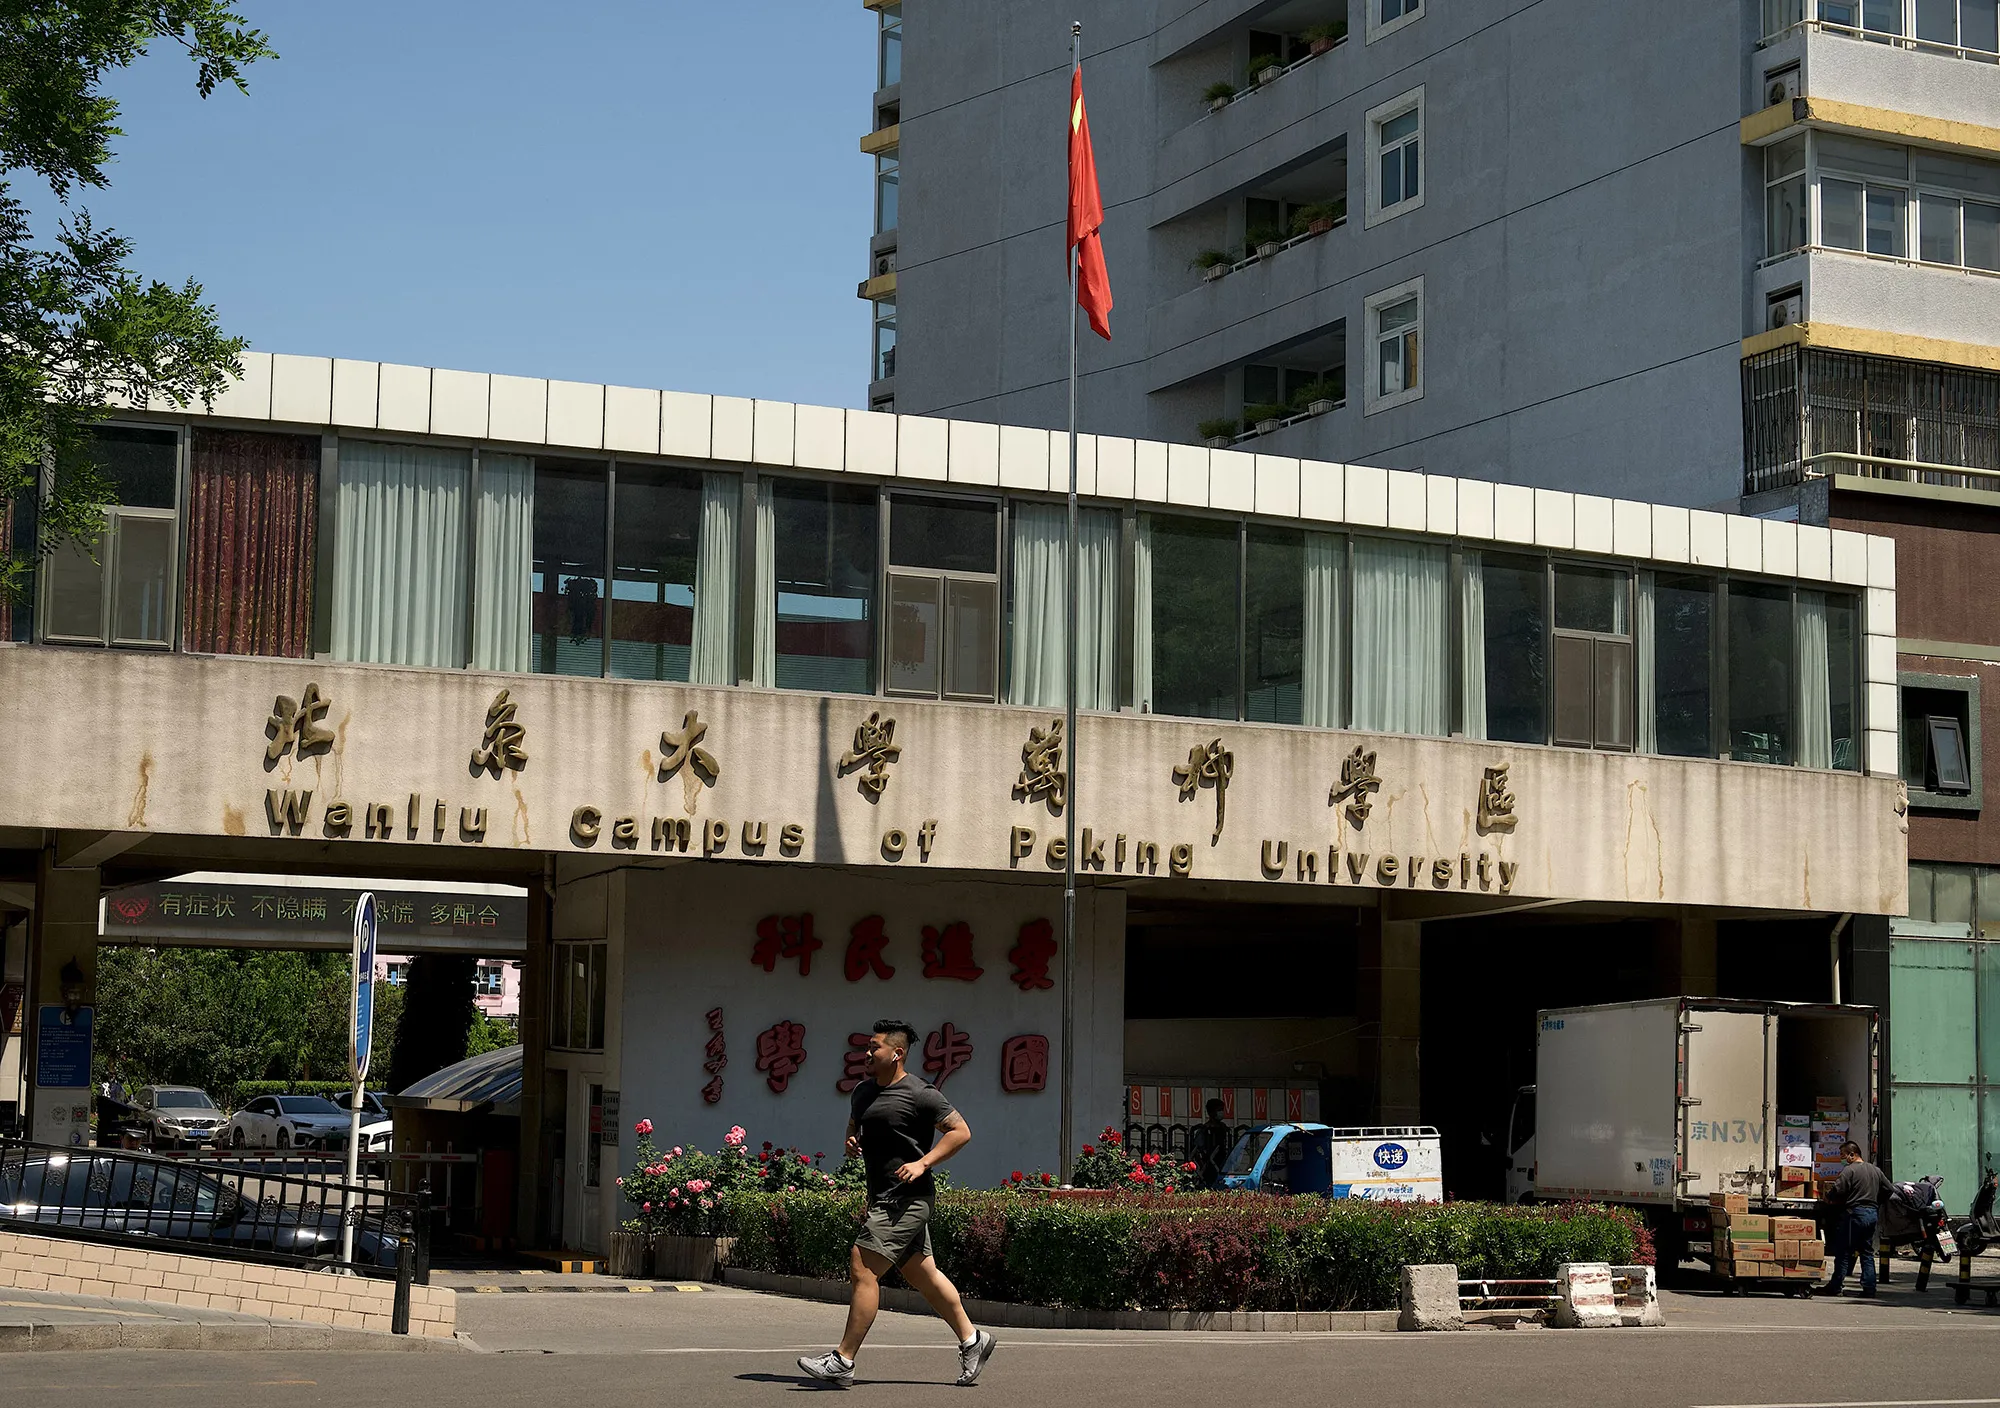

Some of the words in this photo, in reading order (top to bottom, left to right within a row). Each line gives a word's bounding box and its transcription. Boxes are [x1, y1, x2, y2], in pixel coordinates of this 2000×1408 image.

[265, 789, 488, 841] Wanliu
[570, 804, 804, 857] Campus
[882, 818, 938, 858] of
[1011, 826, 1193, 875] Peking
[1261, 840, 1519, 893] University
[159, 892, 236, 918] 有症状
[252, 896, 327, 921] 不隐瞒
[429, 902, 500, 927] 多配合
[1132, 1091, 1140, 1110] S
[1162, 1092, 1170, 1112] T
[1193, 1093, 1201, 1113] U
[1224, 1093, 1233, 1114] V
[1255, 1096, 1266, 1113] W
[1290, 1094, 1300, 1116] X
[1690, 1120, 1764, 1144] 京N3V
[1378, 1148, 1404, 1165] 快递
